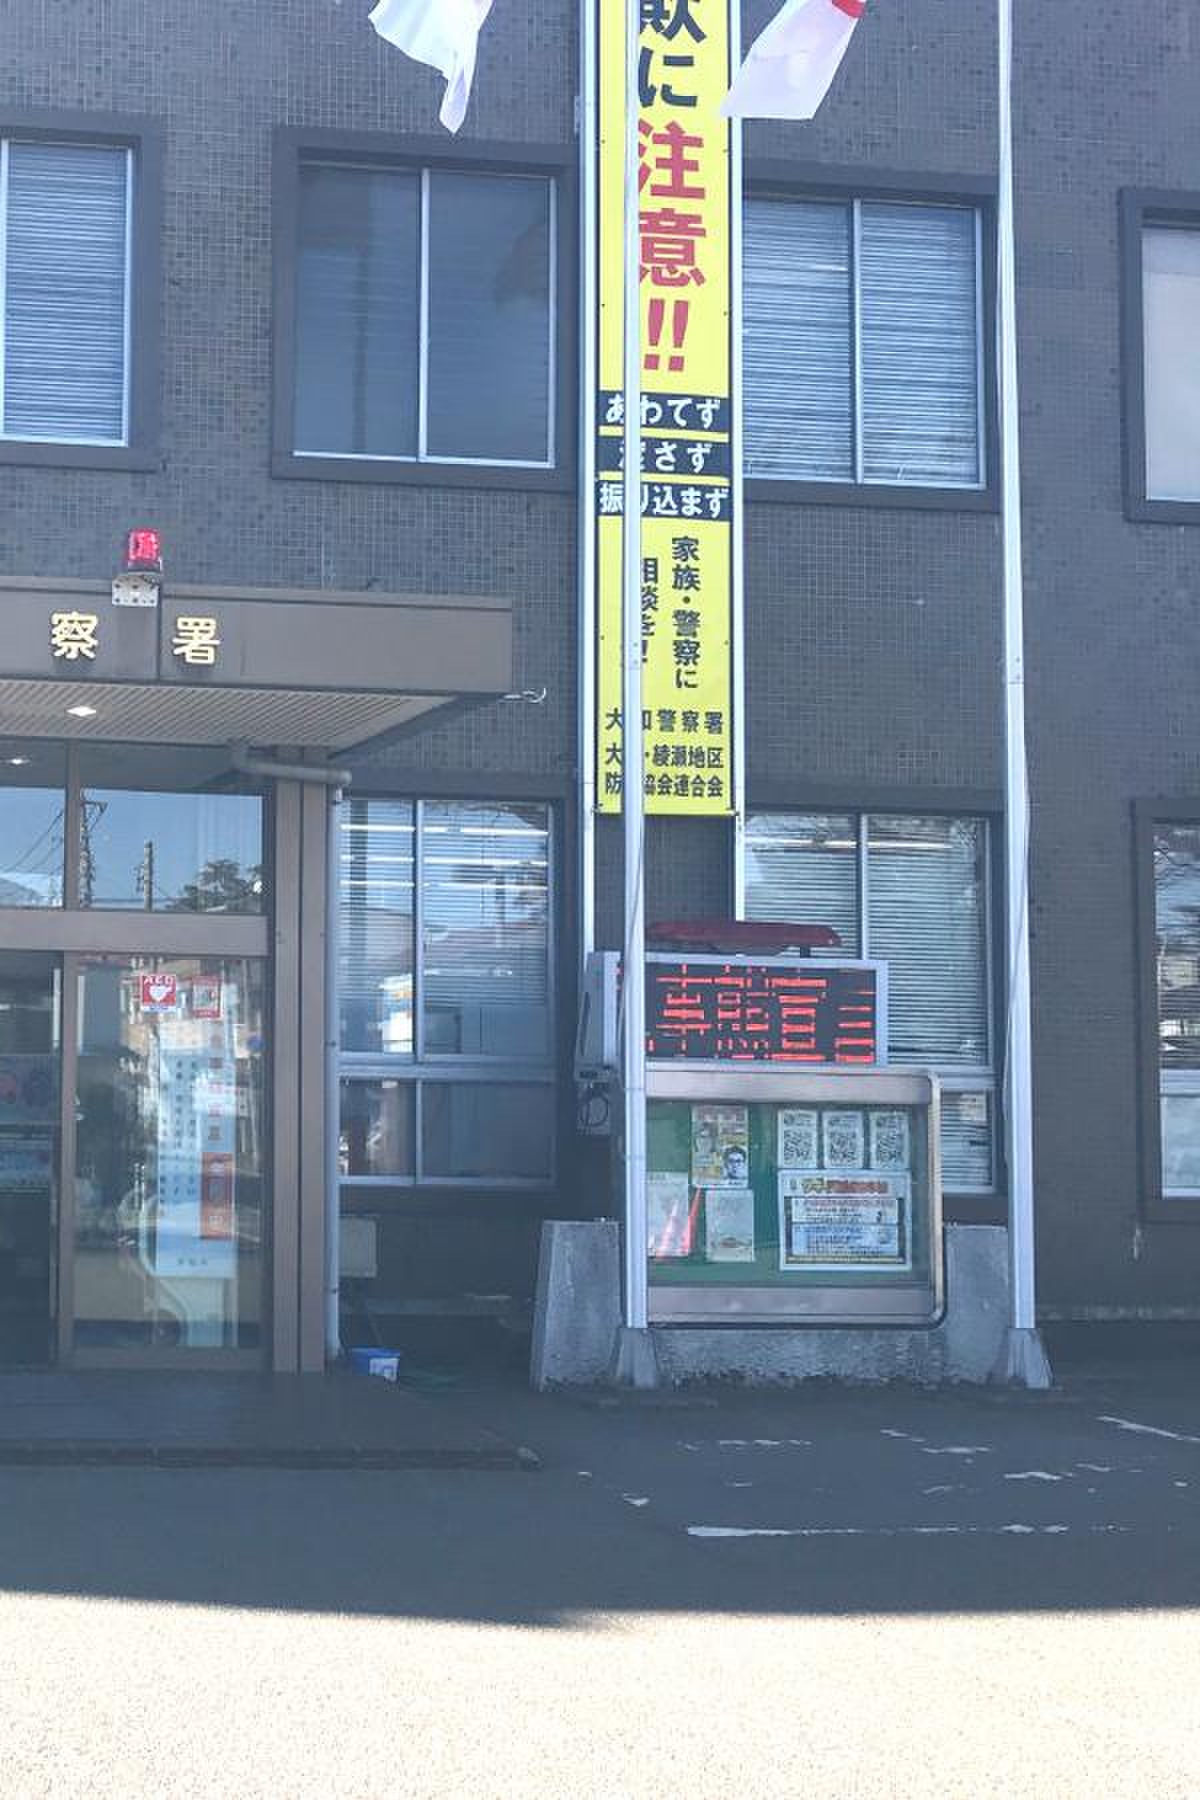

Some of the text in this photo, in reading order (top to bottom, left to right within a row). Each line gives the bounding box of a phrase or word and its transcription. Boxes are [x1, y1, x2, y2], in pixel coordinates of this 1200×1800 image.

[605, 742, 724, 769] 大・綾瀬地区
[605, 771, 723, 797] 防協会連合会
